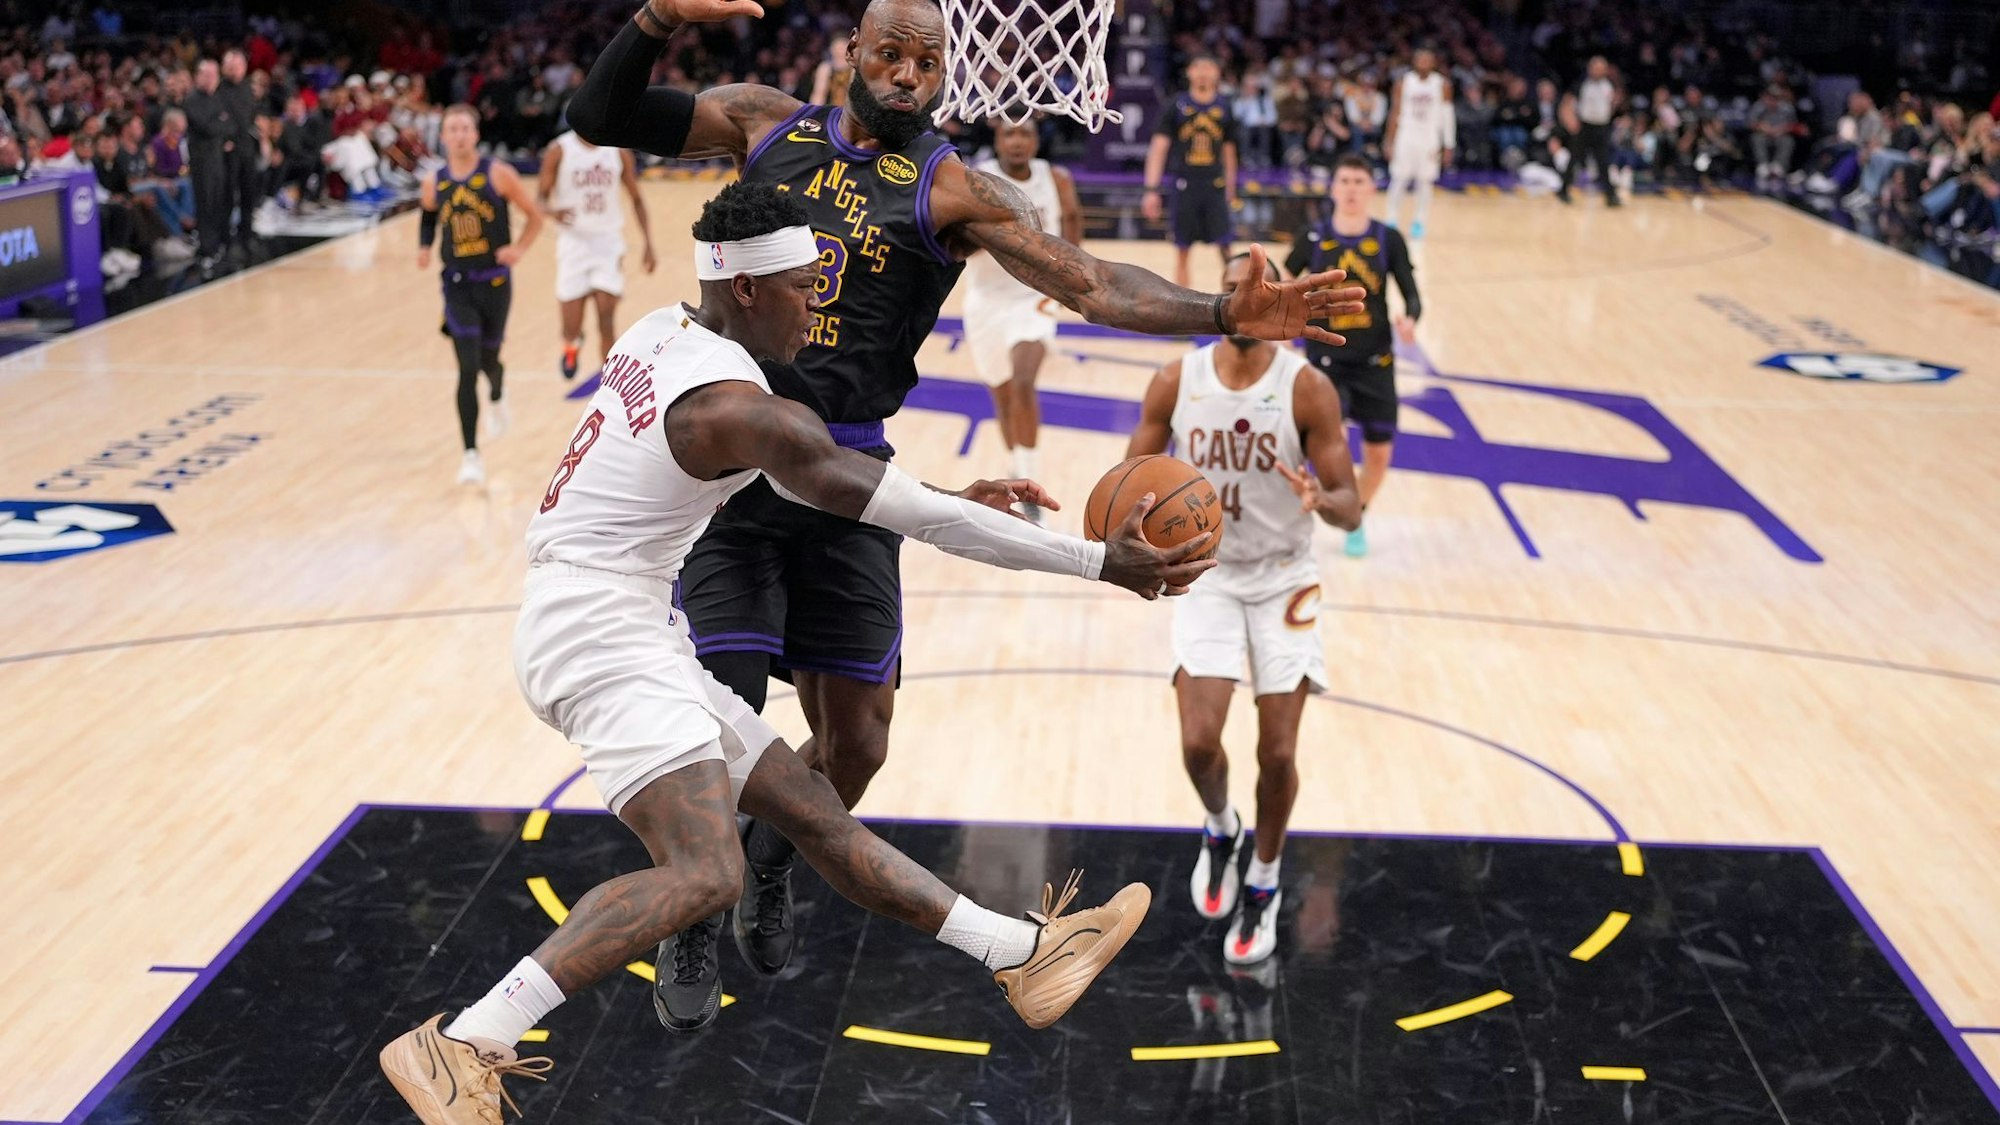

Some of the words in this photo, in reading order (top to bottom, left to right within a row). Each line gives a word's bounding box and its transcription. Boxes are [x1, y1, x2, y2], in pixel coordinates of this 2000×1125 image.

[881, 157, 915, 179] bibigo
[0, 225, 40, 267] OTA
[804, 160, 891, 273] ANGELES
[814, 230, 849, 308] 3
[602, 353, 657, 439] CHRÖDER
[540, 408, 605, 515] 8
[1190, 426, 1277, 473] CAVS
[1221, 483, 1242, 522] 4
